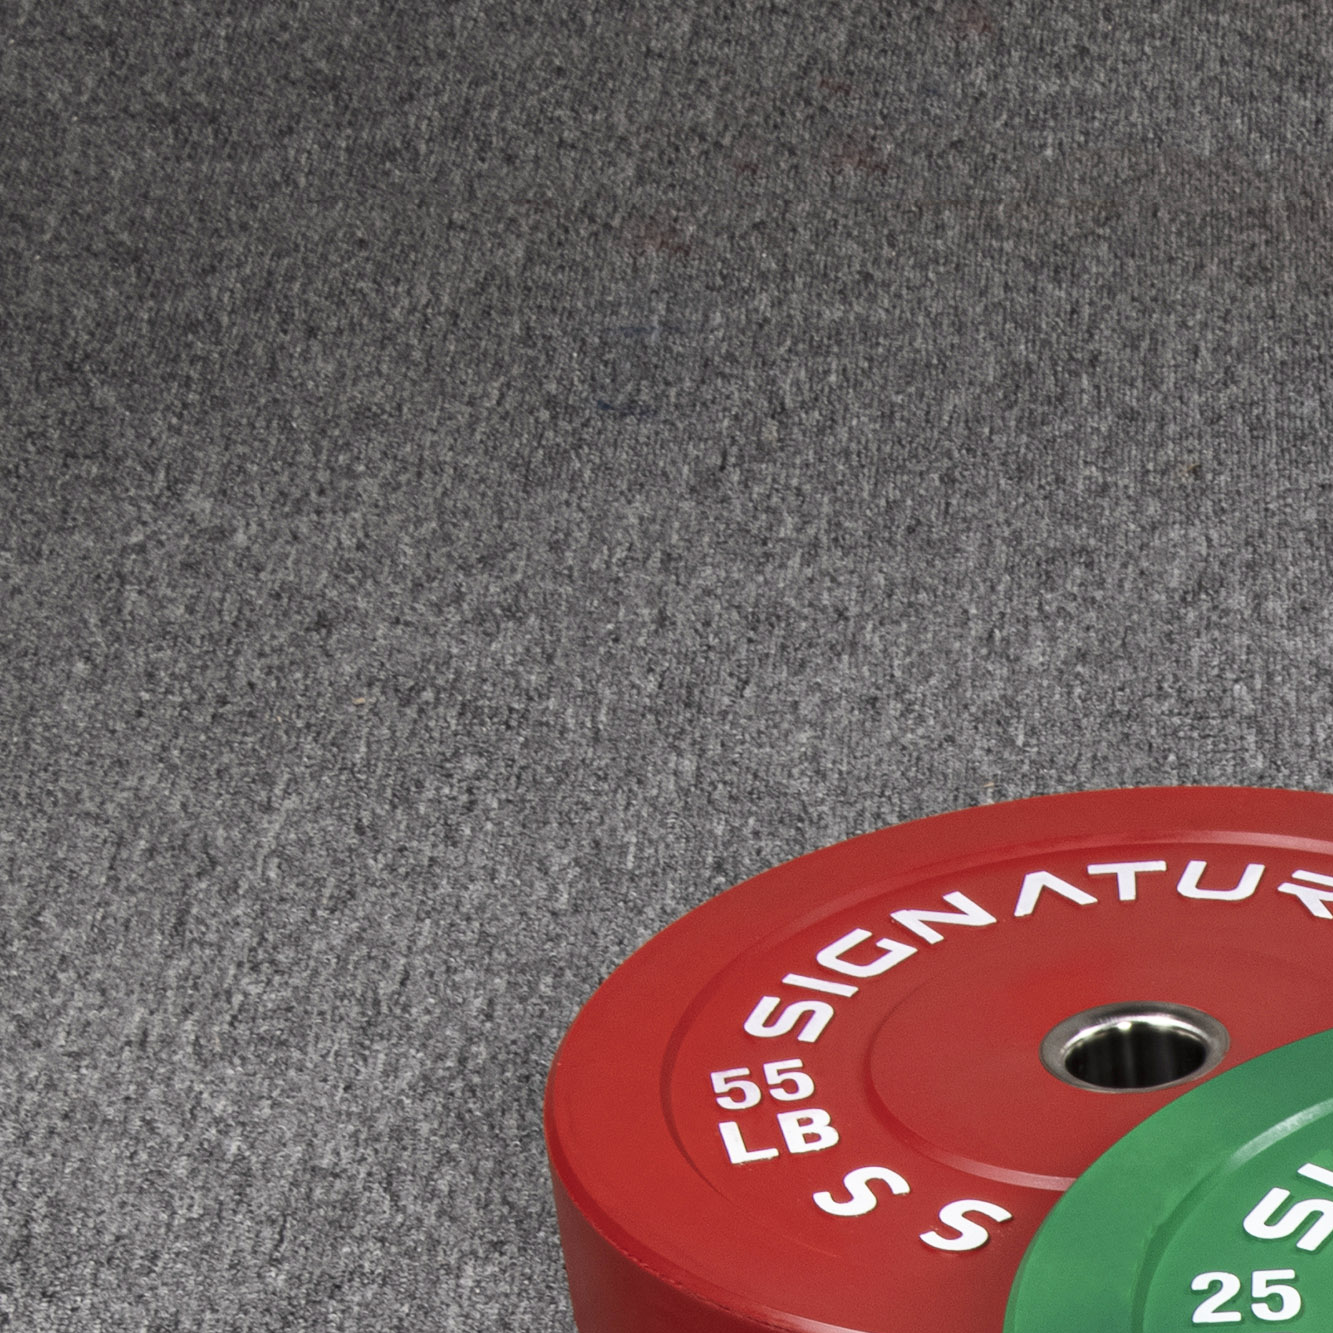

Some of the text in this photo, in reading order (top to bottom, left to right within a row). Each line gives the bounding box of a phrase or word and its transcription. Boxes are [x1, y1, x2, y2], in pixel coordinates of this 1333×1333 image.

[710, 1058, 815, 1110] 55
[718, 1108, 840, 1164] LB
[1190, 1268, 1303, 1324] 25
